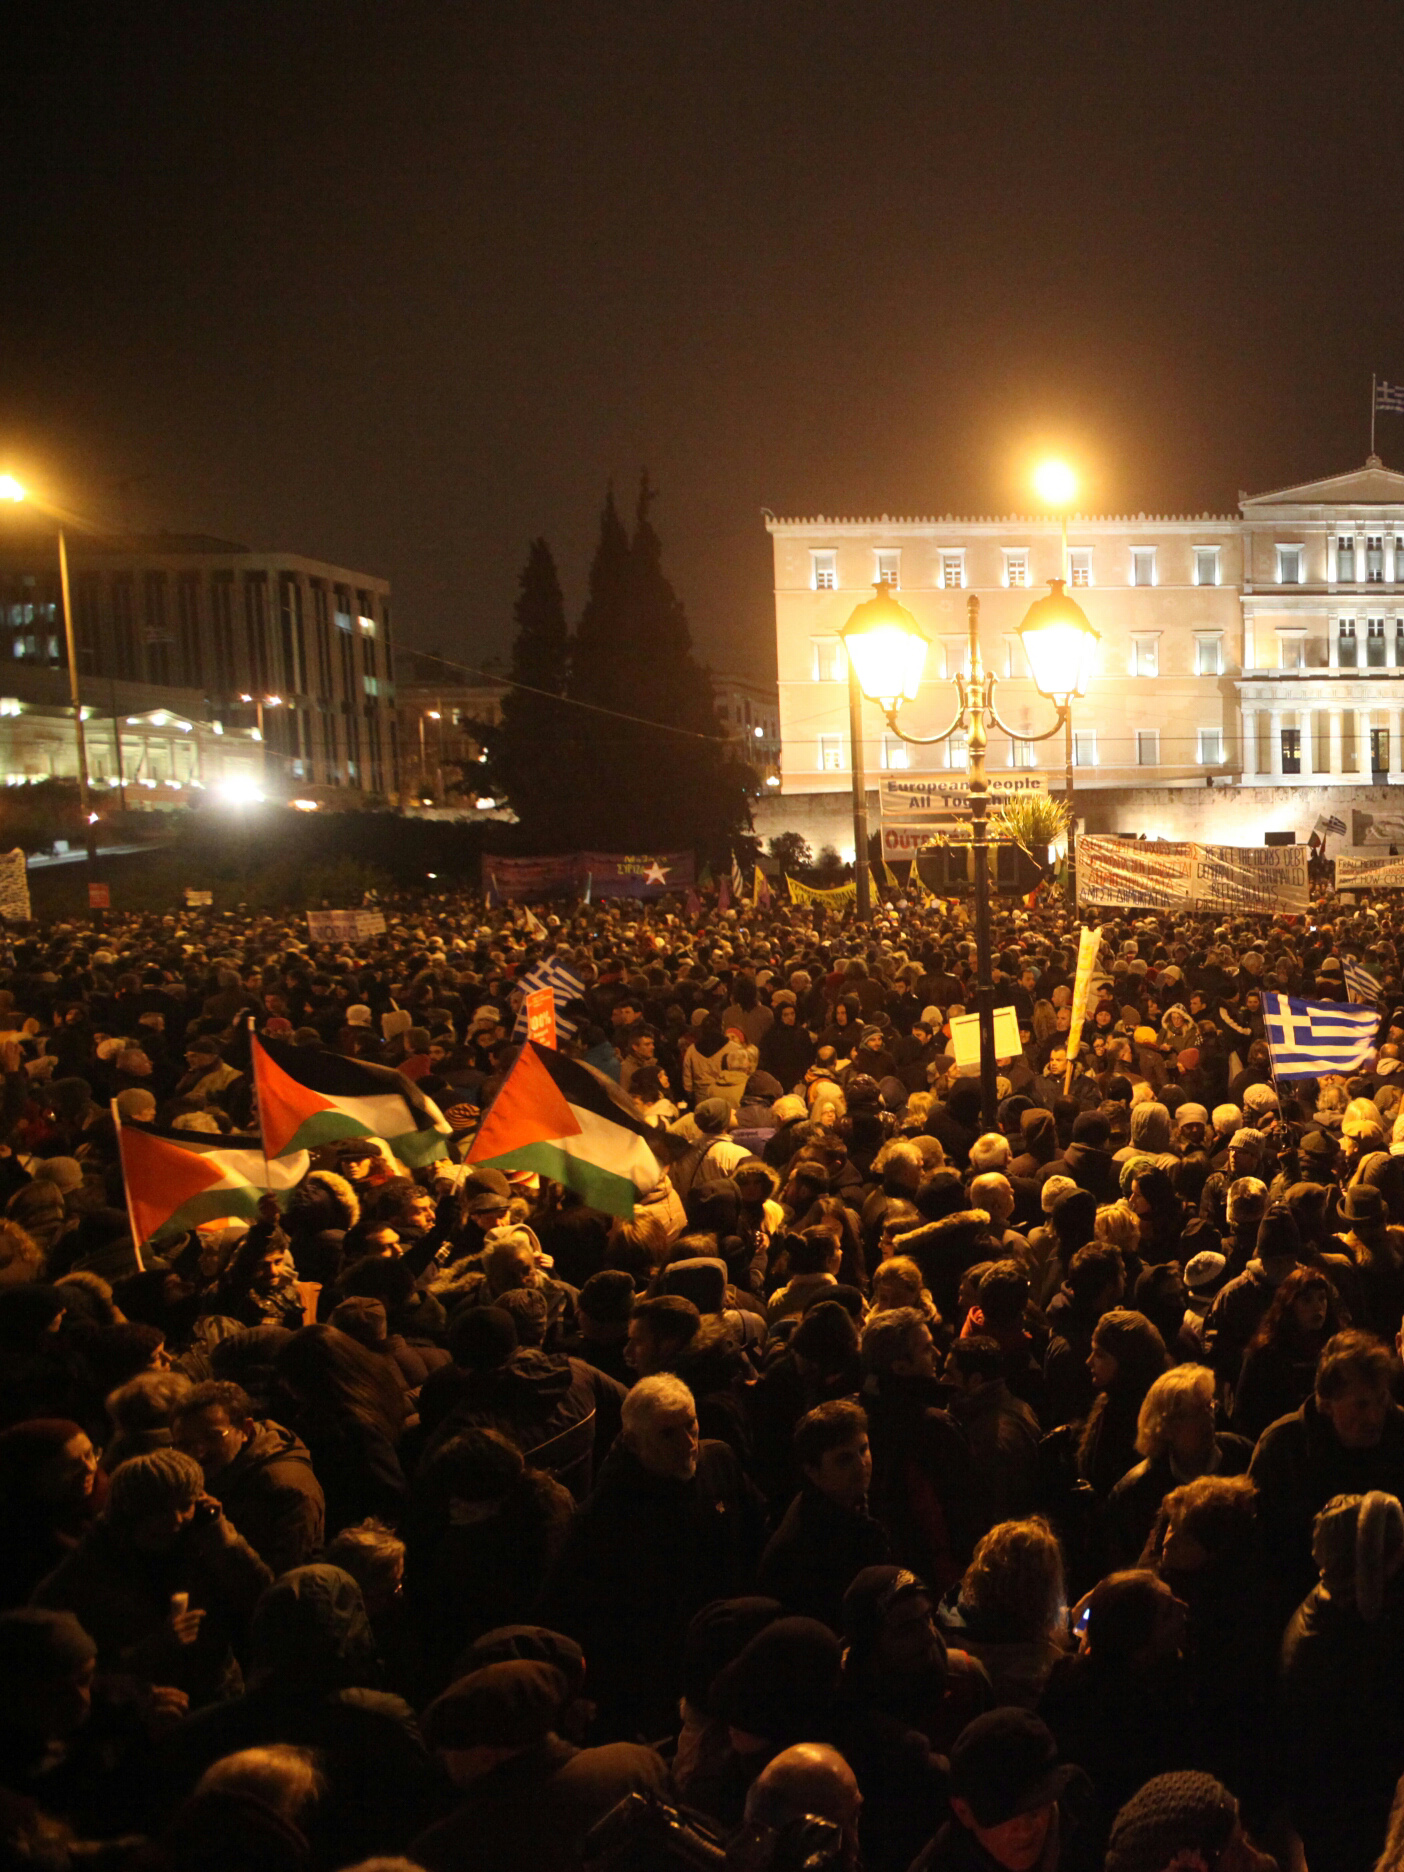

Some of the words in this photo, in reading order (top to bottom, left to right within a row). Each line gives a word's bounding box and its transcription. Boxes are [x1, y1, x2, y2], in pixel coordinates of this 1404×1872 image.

[888, 780, 970, 795] European
[909, 796, 930, 808] All
[1237, 848, 1252, 866] THE
[1283, 848, 1305, 867] DEBT
